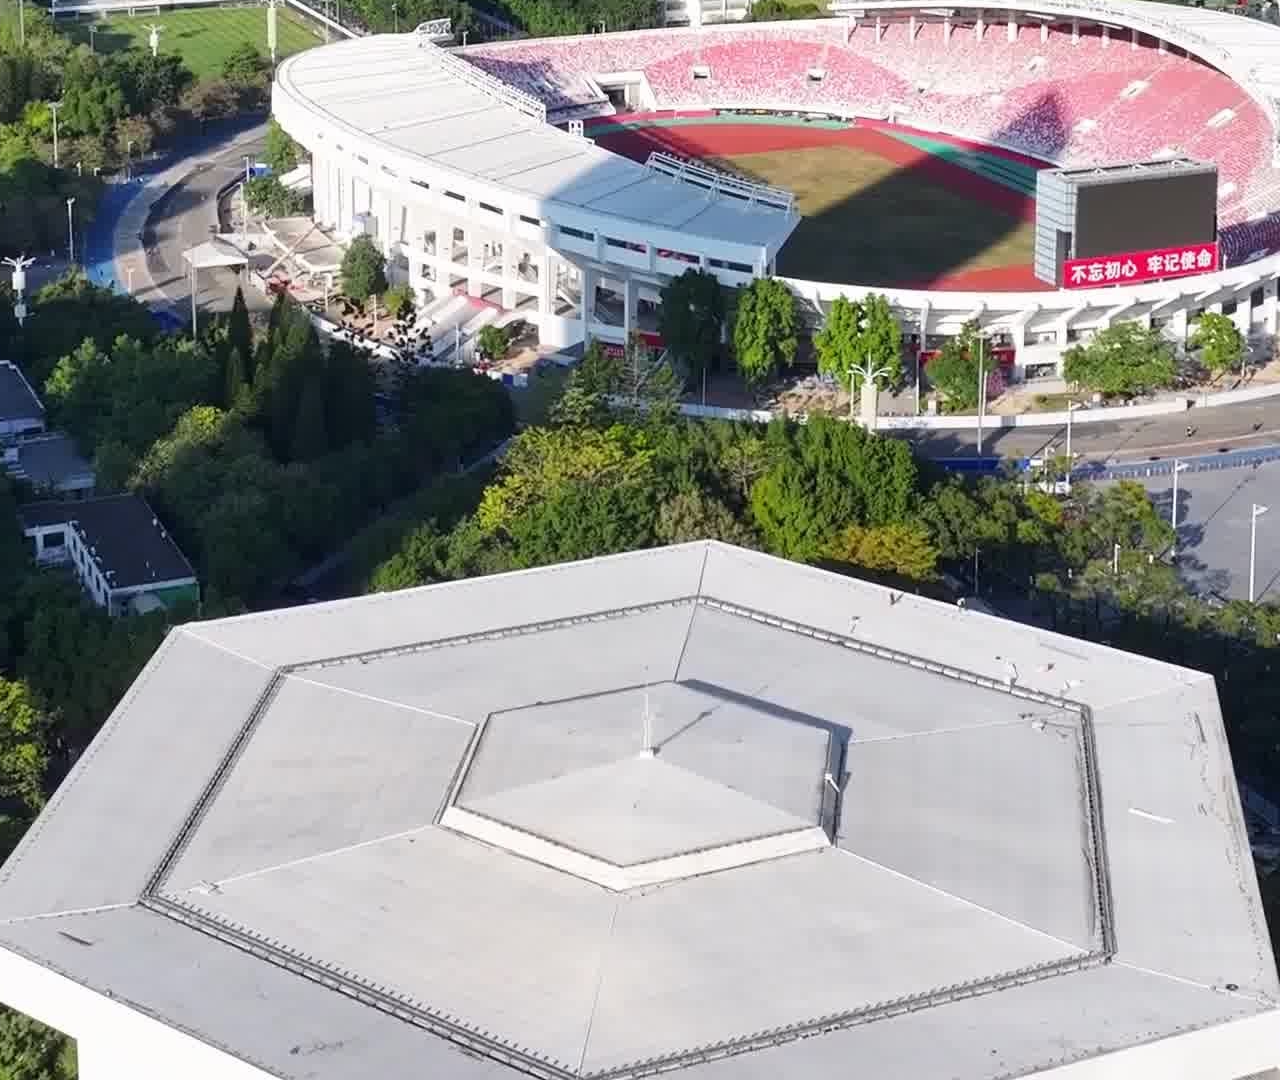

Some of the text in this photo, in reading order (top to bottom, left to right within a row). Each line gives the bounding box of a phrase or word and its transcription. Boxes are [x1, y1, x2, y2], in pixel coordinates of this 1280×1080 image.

[1071, 248, 1213, 284] 不忘初心 牢记使命
